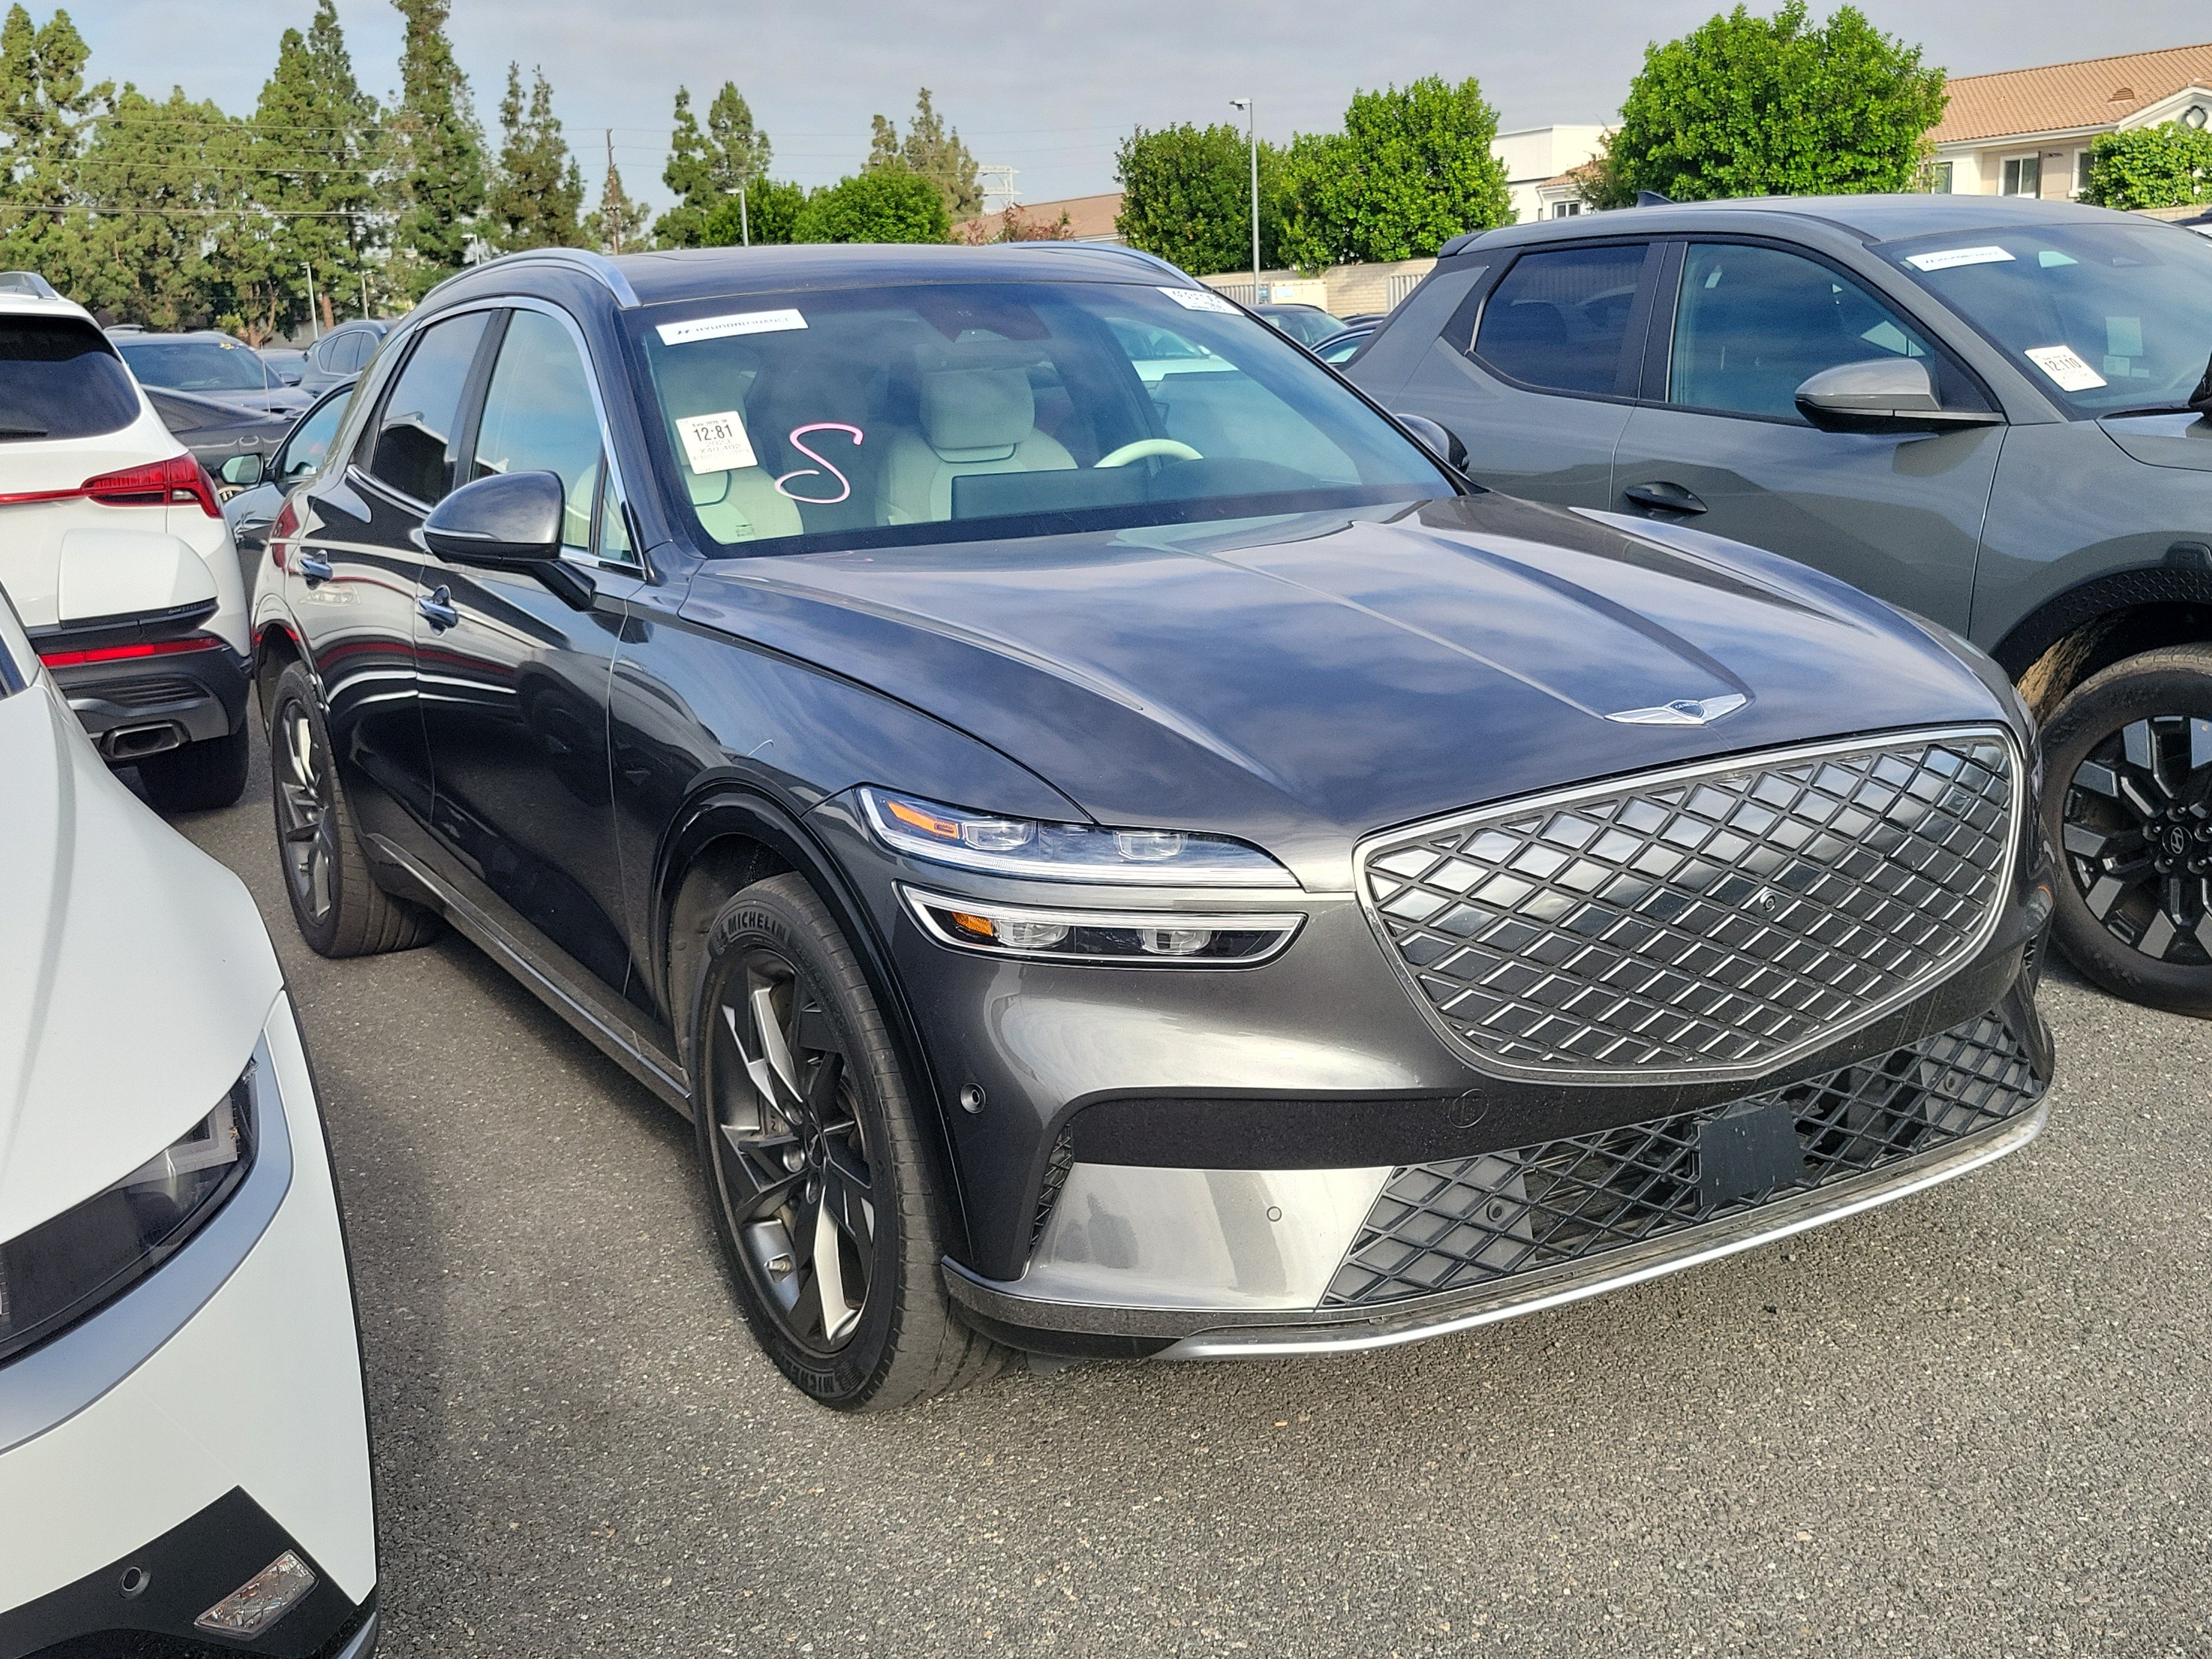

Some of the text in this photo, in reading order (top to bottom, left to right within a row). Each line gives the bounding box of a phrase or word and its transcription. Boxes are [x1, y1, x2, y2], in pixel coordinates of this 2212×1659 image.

[2044, 357, 2082, 373] 12:110
[693, 424, 733, 442] 12:81
[706, 439, 731, 447] 2023
[774, 422, 865, 504] S
[727, 911, 786, 941] MICHELIN
